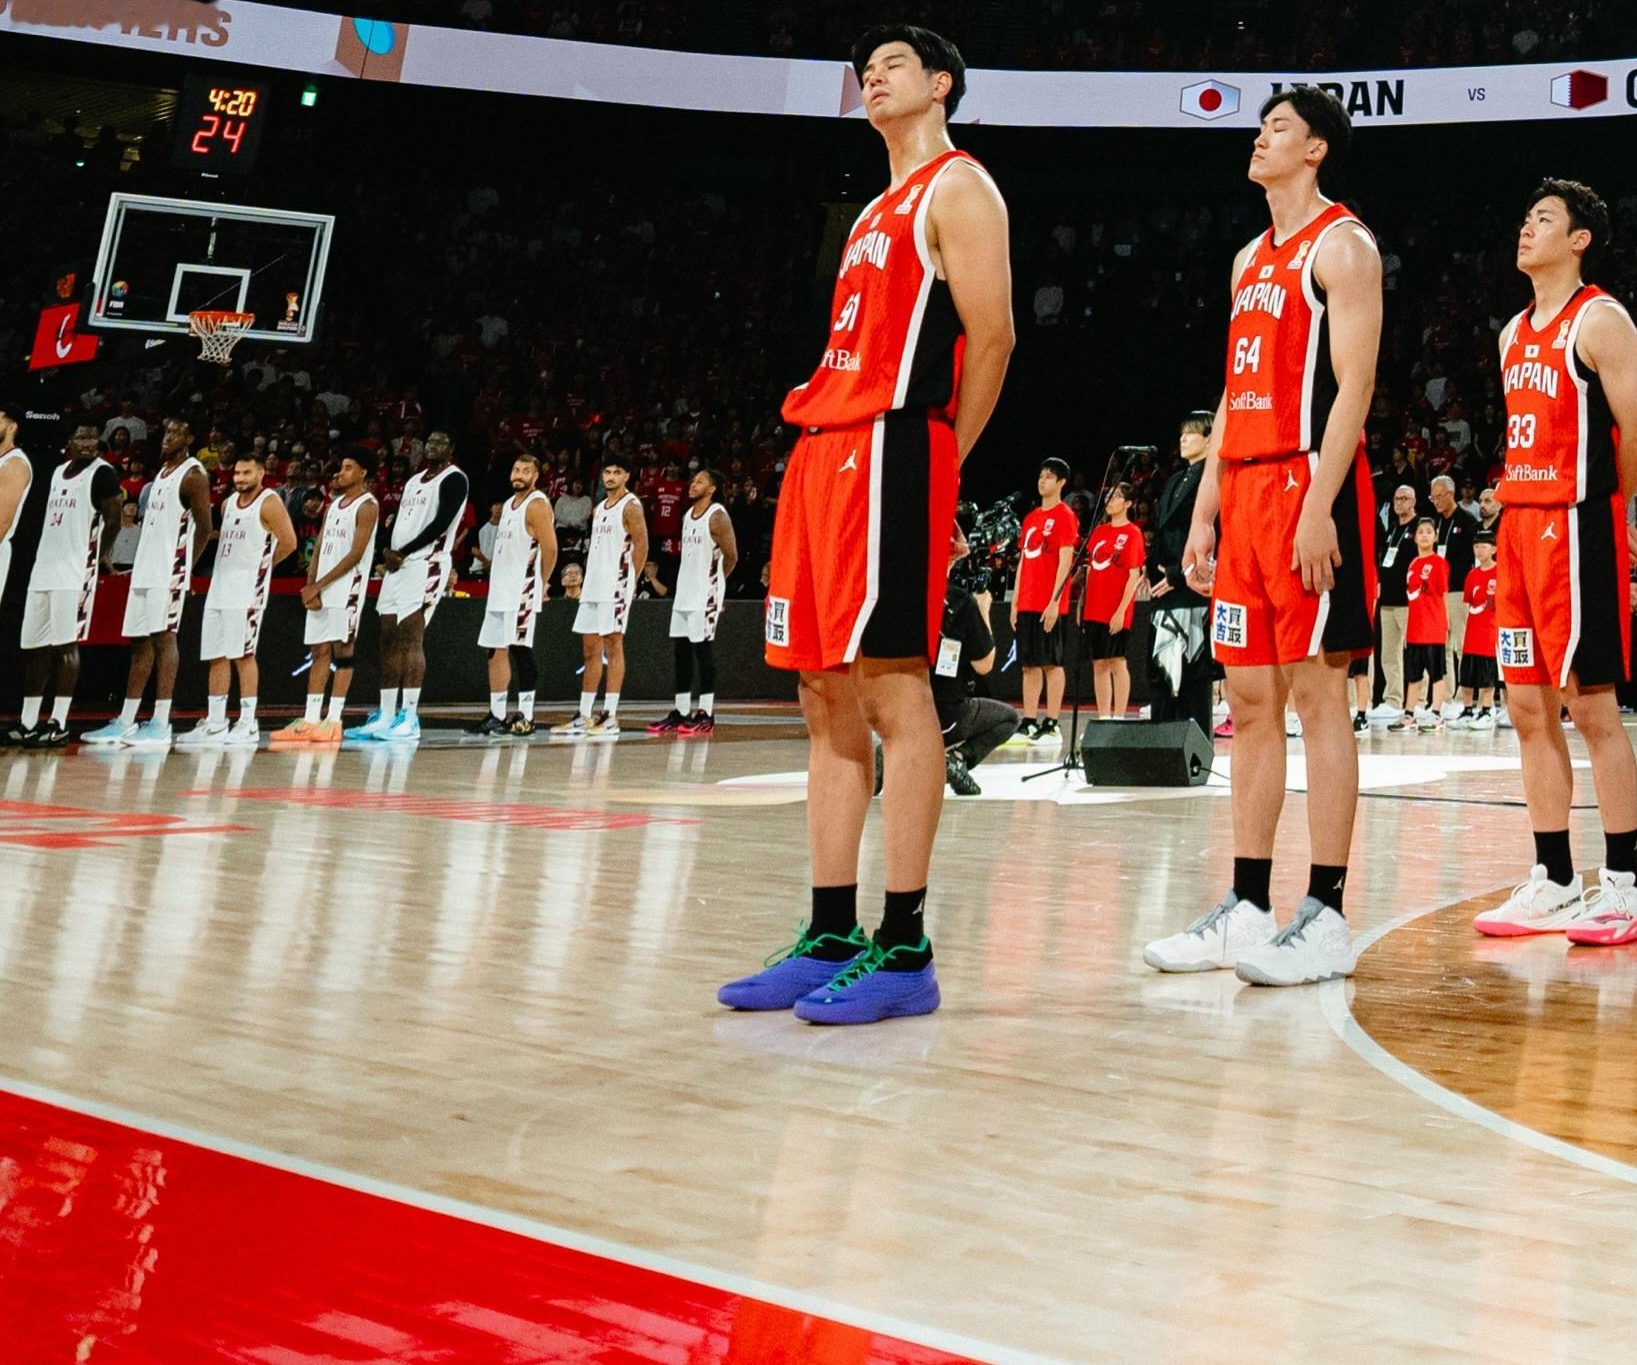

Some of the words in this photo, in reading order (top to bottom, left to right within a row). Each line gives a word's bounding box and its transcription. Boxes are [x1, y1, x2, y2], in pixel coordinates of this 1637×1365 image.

[209, 89, 256, 116] 4:20
[1467, 87, 1486, 101] VS
[192, 115, 246, 153] 24
[839, 230, 892, 279] JAPAN
[833, 292, 861, 332] 91
[1231, 281, 1287, 322] JAPAN
[1233, 335, 1261, 374] 64
[1504, 362, 1559, 400] JAPAN
[1229, 390, 1273, 411] SoftBank
[1508, 413, 1537, 449] 33
[1506, 464, 1559, 483] SoftBank
